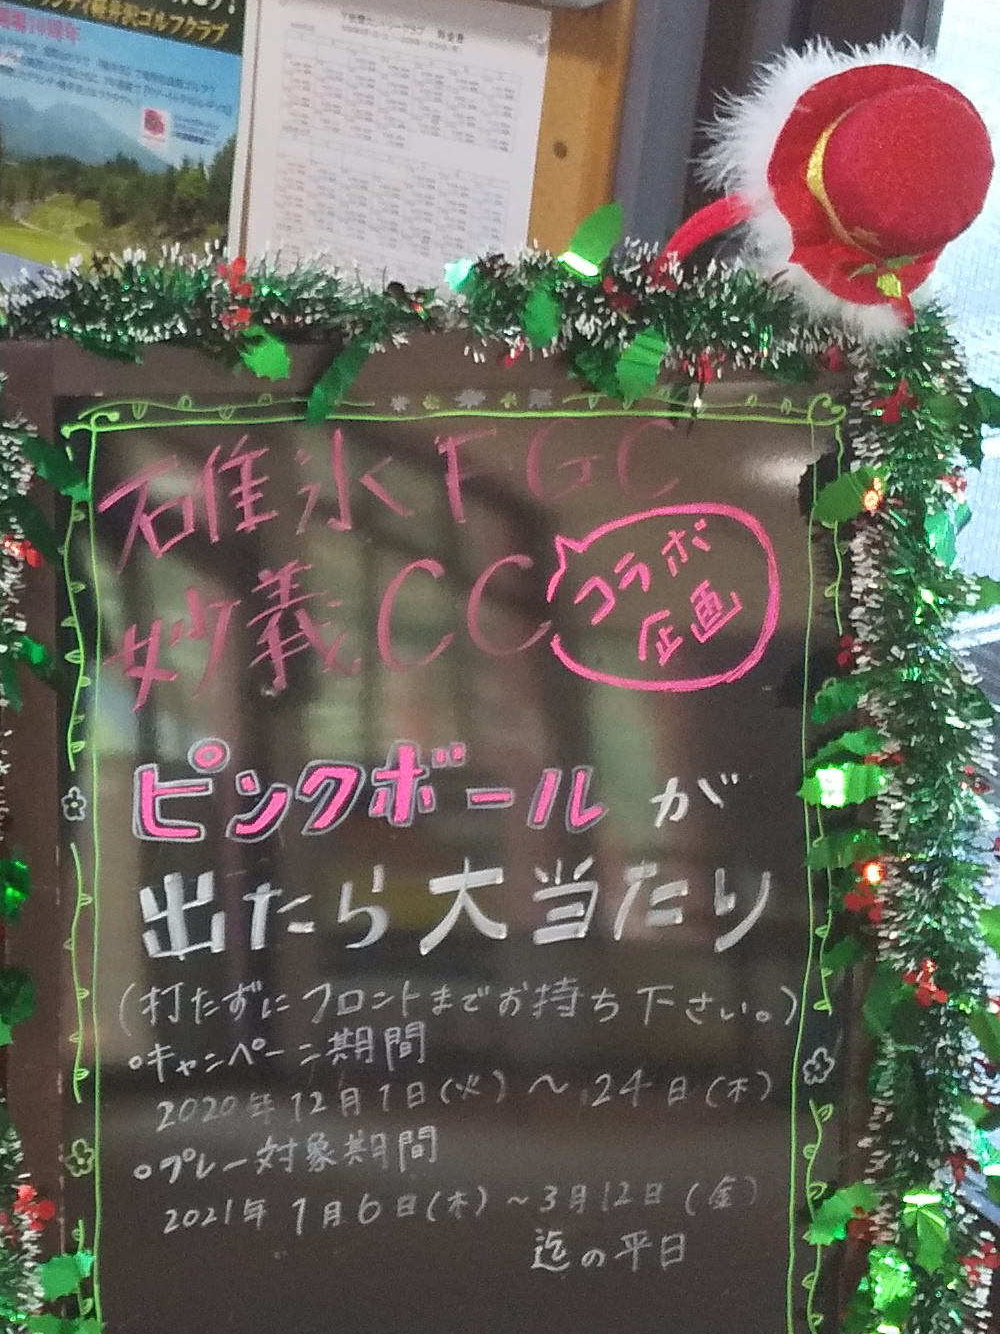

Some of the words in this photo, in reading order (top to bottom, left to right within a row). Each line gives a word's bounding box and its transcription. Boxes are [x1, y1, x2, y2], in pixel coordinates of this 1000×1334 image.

[573, 518, 712, 627] コラボ
[637, 579, 743, 667] 企画
[530, 1228, 687, 1272] 迄の平日
